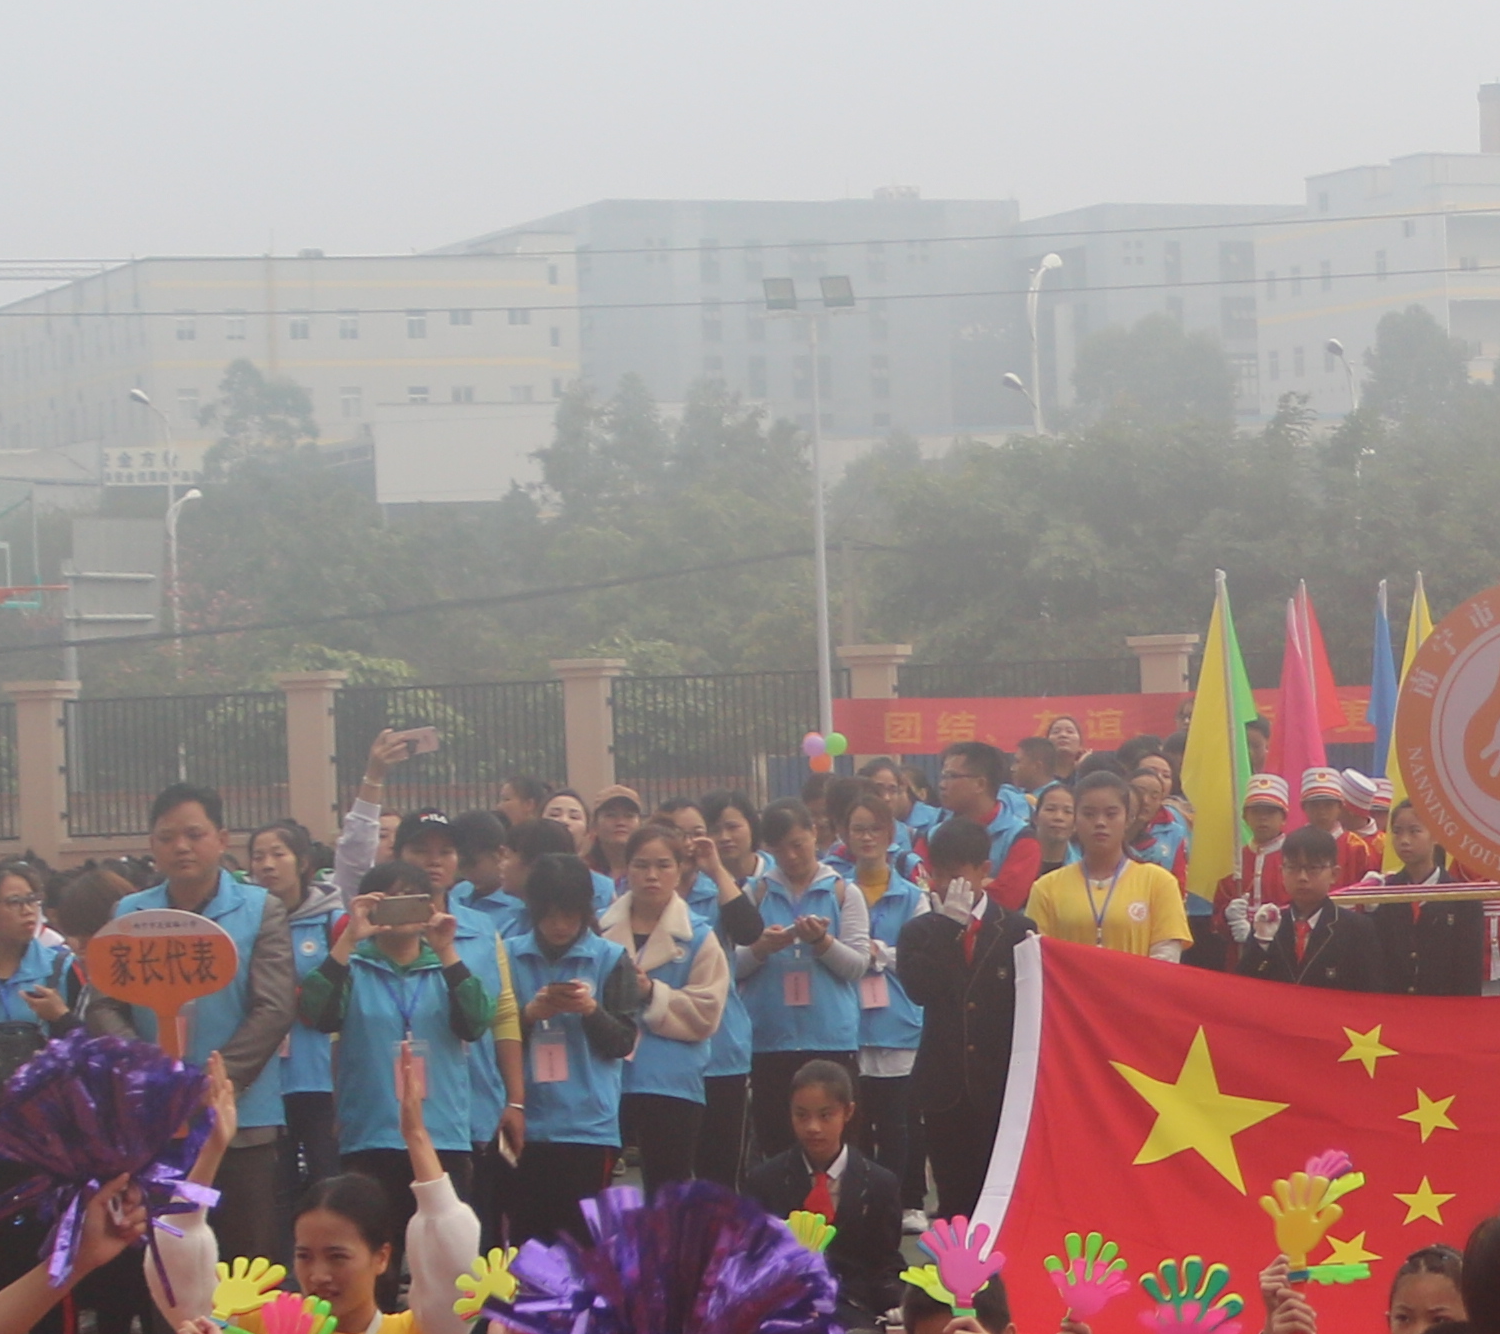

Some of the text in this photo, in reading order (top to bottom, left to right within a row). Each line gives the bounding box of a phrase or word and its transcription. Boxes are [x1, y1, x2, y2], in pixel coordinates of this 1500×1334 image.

[1406, 746, 1459, 837] NANNING
[109, 937, 218, 987] 家长代表
